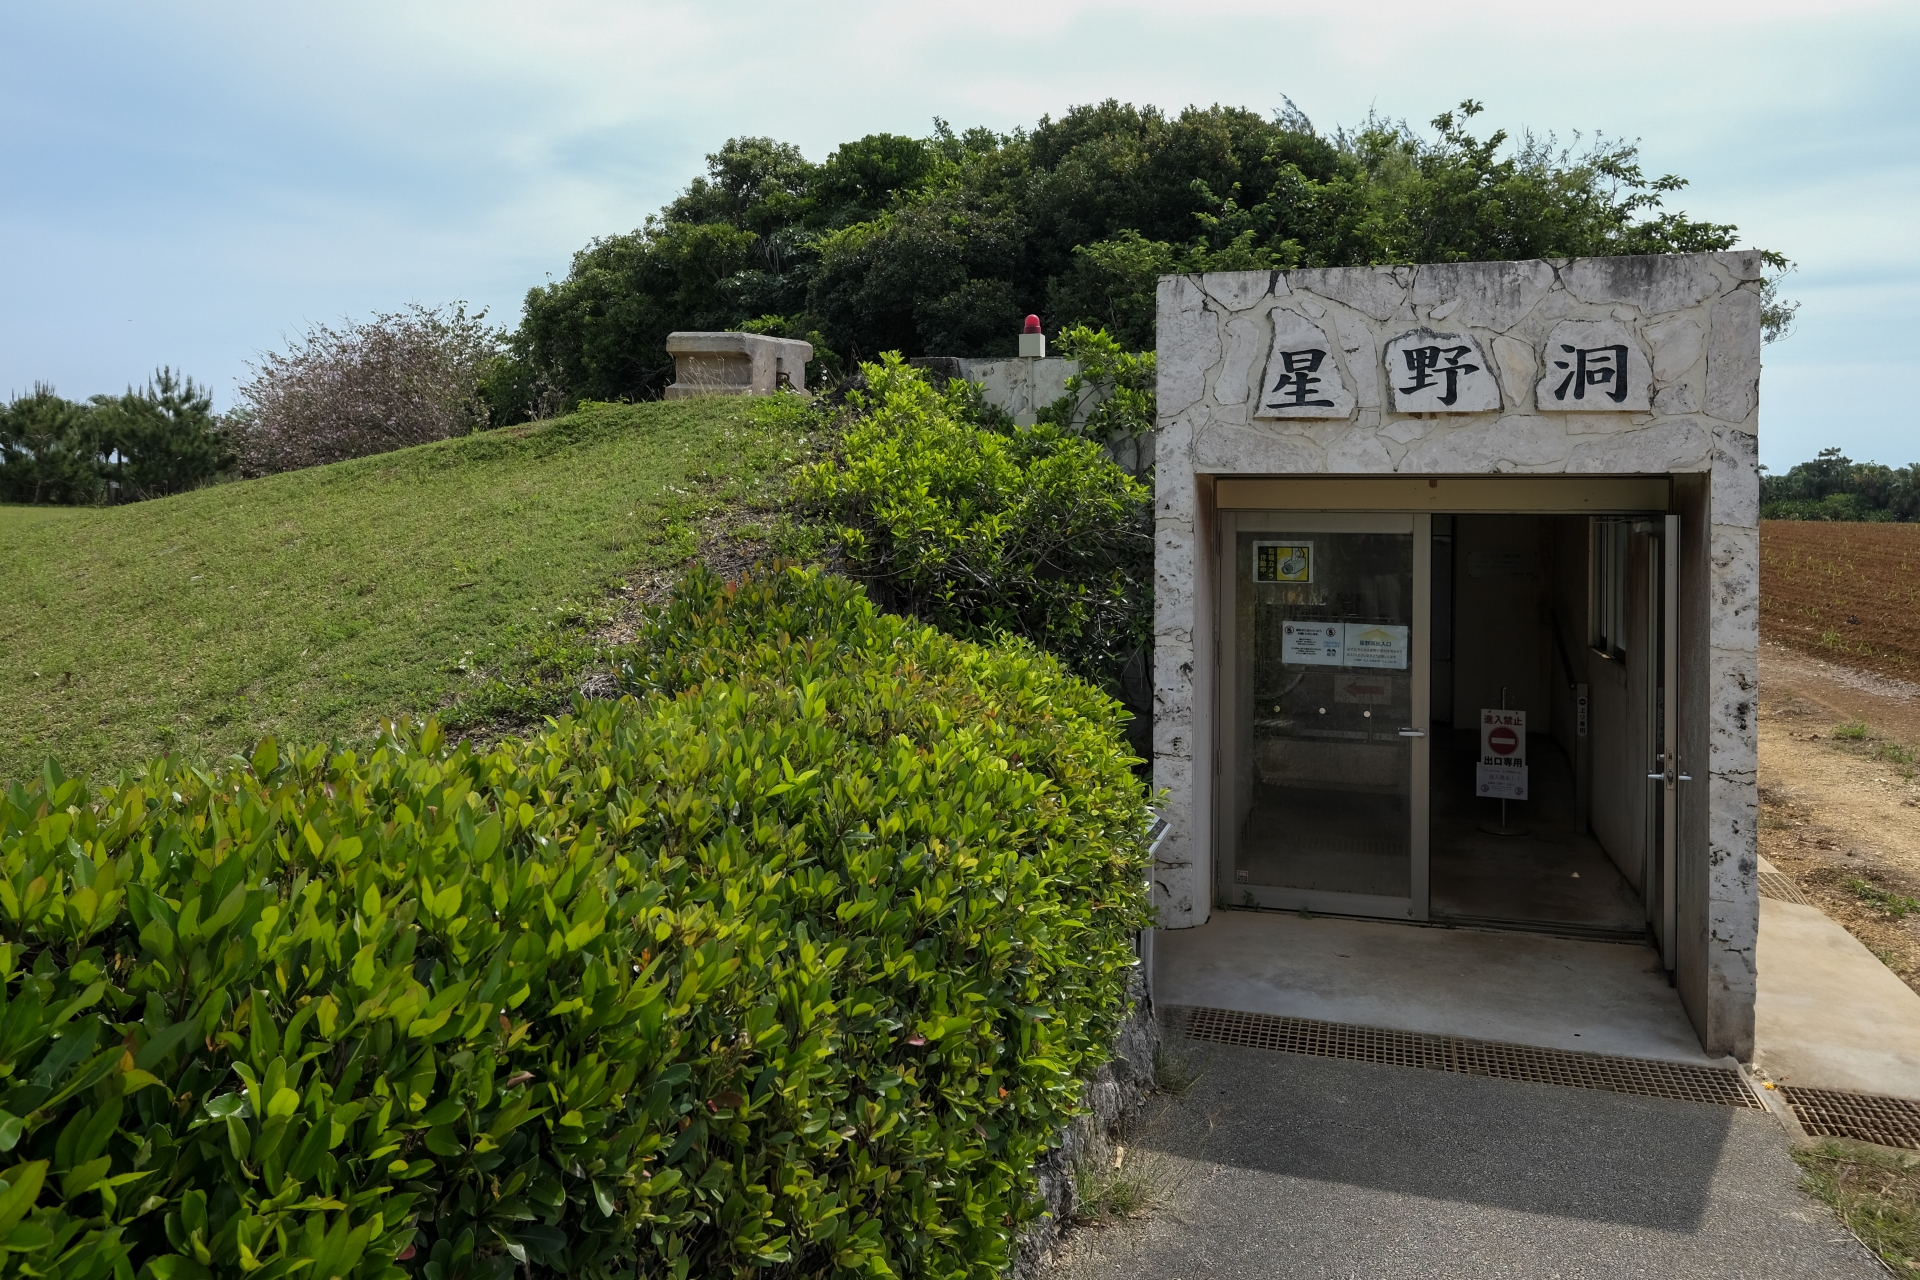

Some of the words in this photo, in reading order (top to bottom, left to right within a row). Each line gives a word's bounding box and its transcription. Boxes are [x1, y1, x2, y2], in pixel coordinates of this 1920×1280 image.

[1266, 344, 1629, 409] 星野洞
[1484, 714, 1523, 726] 進入禁止
[1484, 756, 1523, 768] 出口専用
